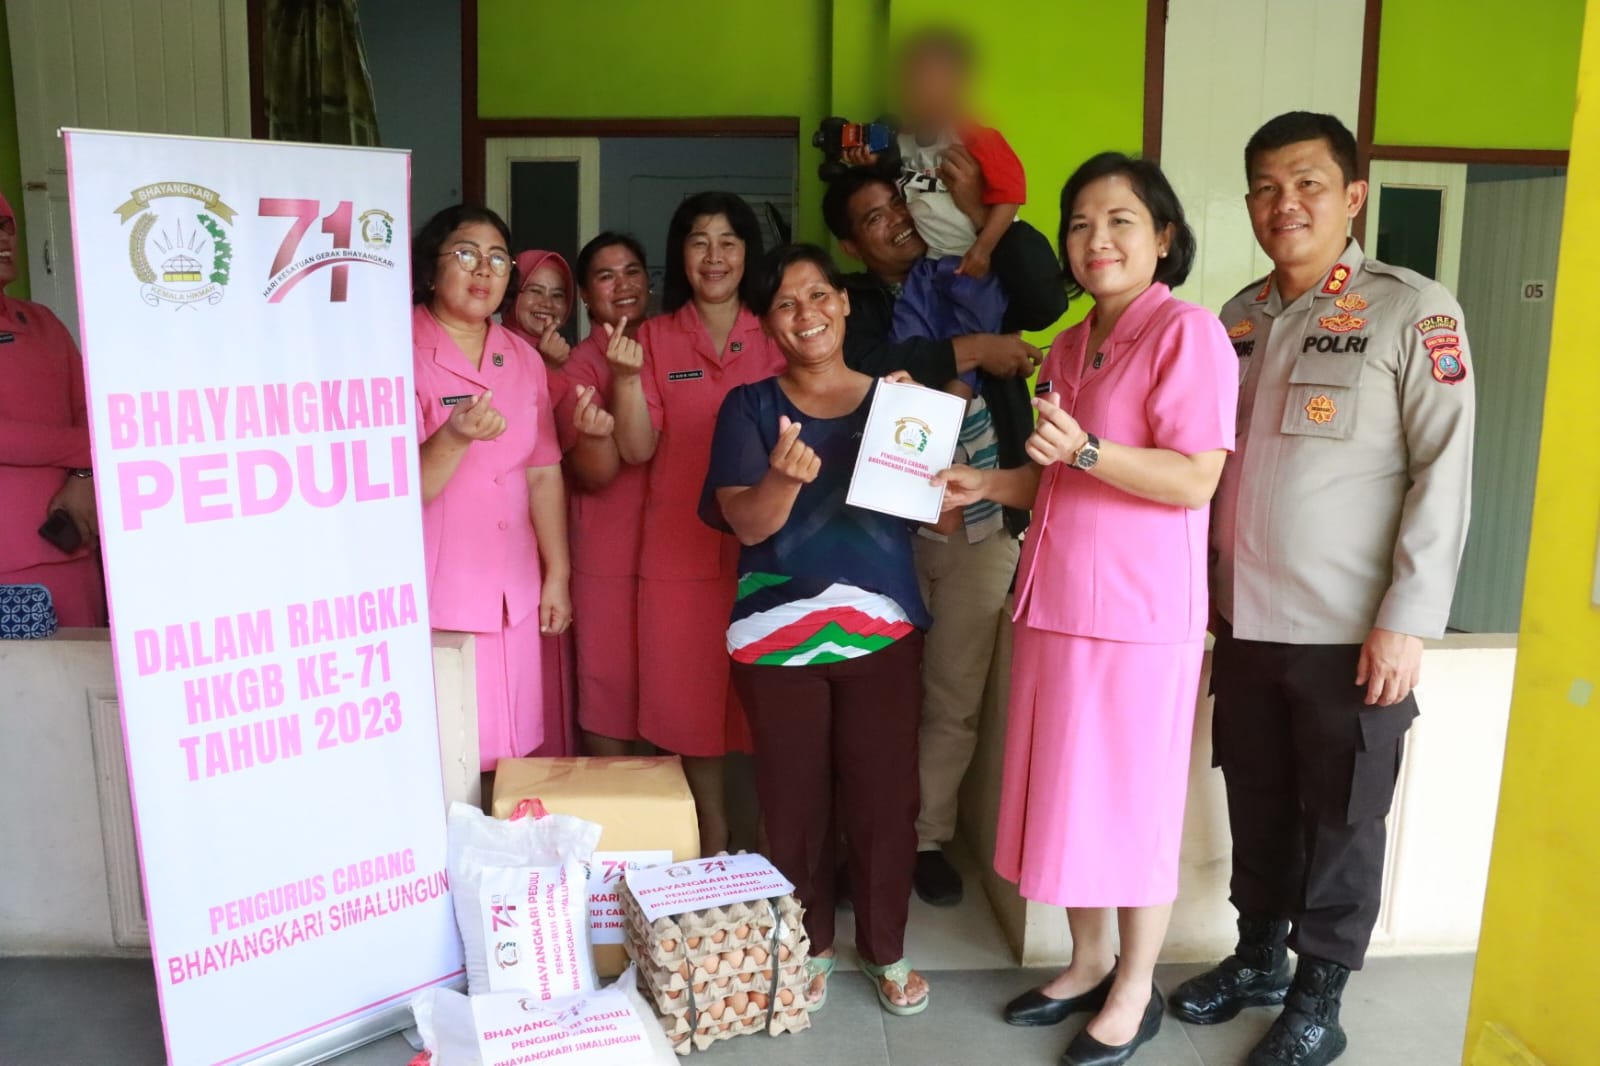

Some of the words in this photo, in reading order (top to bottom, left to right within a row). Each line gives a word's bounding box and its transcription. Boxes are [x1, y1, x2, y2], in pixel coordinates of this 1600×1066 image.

[138, 183, 214, 201] BHAYANGKARI
[258, 197, 353, 302] 71
[262, 280, 279, 298] HARI
[277, 256, 316, 283] KESATUAN
[315, 249, 341, 261] GERAK
[342, 249, 395, 268] BHAYANGKARI
[1525, 284, 1544, 298] 05
[1302, 335, 1368, 353] POLRI
[107, 376, 407, 450] BHAYANGKARI
[116, 436, 409, 531] PEDULI
[133, 609, 275, 677] DALAM
[287, 583, 418, 649] RANGKA
[184, 663, 285, 725] HKGB
[297, 641, 391, 701] KE-71
[179, 713, 302, 782] TAHUN
[314, 691, 403, 750] 2023
[208, 875, 327, 935] PENGURUS
[332, 848, 416, 894] CABANG
[527, 872, 540, 904] PEDULI
[589, 893, 620, 902] KARI
[638, 876, 728, 896] BHAYANGKARI
[732, 869, 774, 881] PEDULI
[664, 885, 717, 899] PENGURUS
[719, 879, 761, 889] CABANG
[650, 892, 721, 909] BHAYANGKARI
[168, 914, 324, 985] BHAYANGKARI
[329, 868, 449, 931] SIMALUNGUN
[529, 907, 552, 1001] BHAYANGKARI
[573, 1023, 617, 1037] ABANG
[584, 1008, 632, 1023] PEDULI
[575, 1034, 641, 1052] SIMALUNGUN
